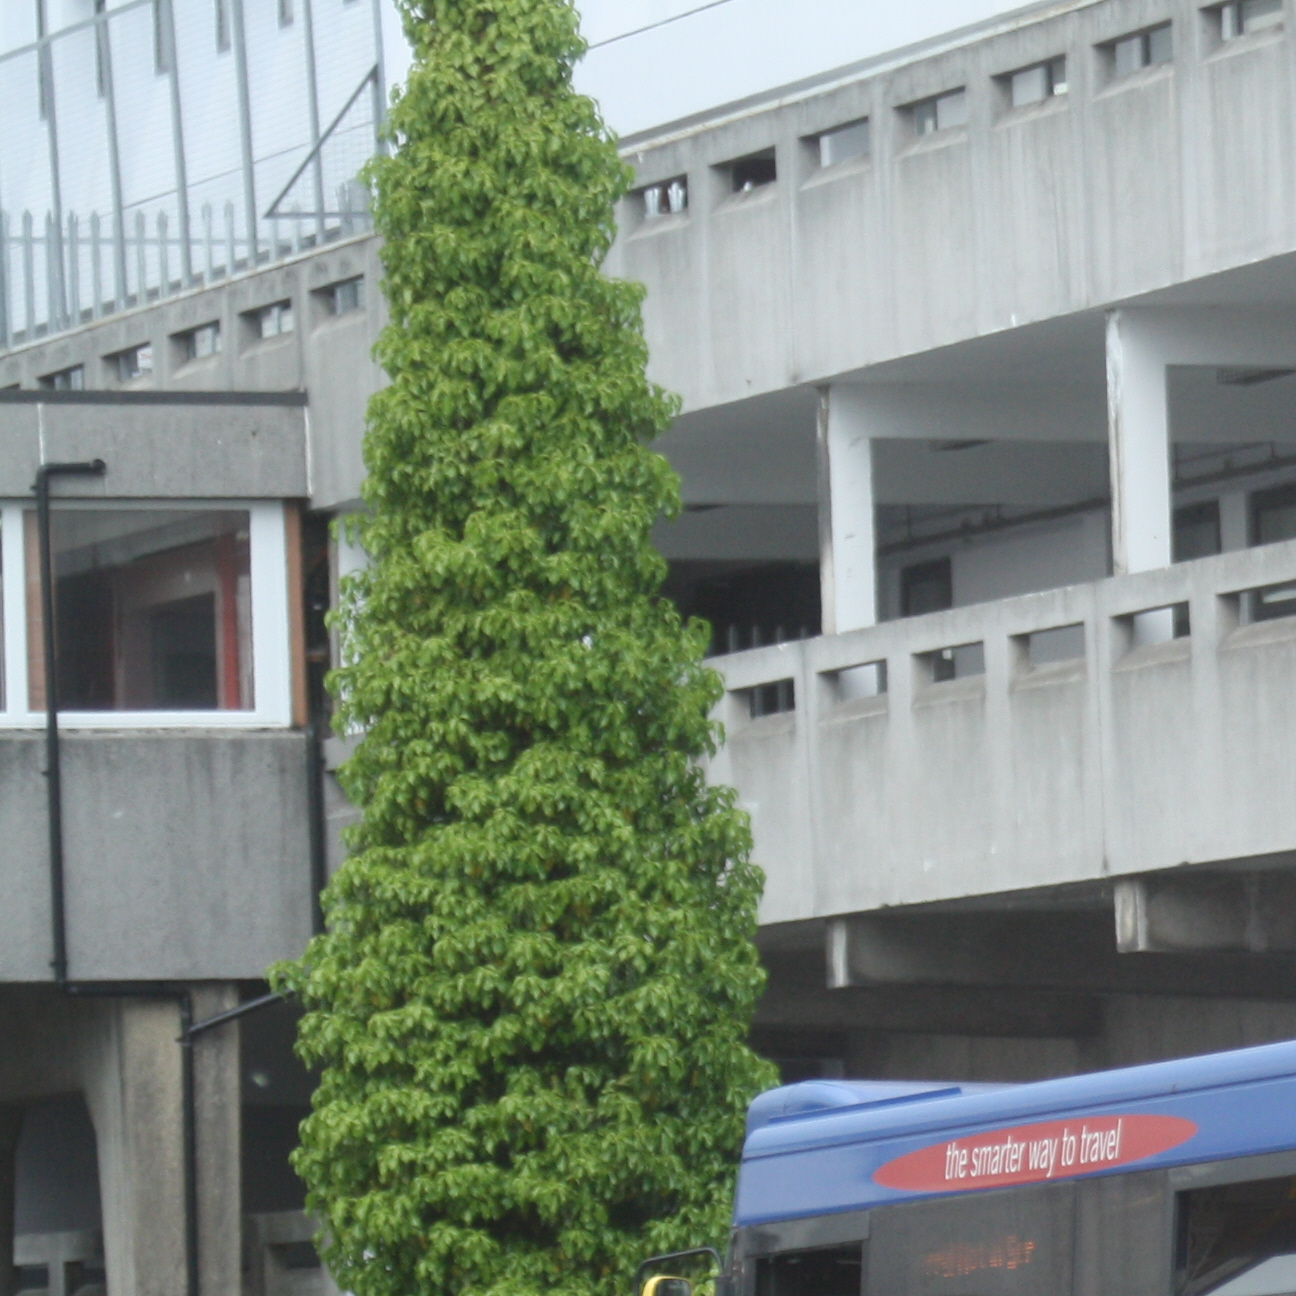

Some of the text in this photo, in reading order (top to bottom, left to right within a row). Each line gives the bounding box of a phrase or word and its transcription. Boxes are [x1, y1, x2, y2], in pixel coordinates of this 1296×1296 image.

[945, 1118, 1123, 1180] the smarter way to travel
